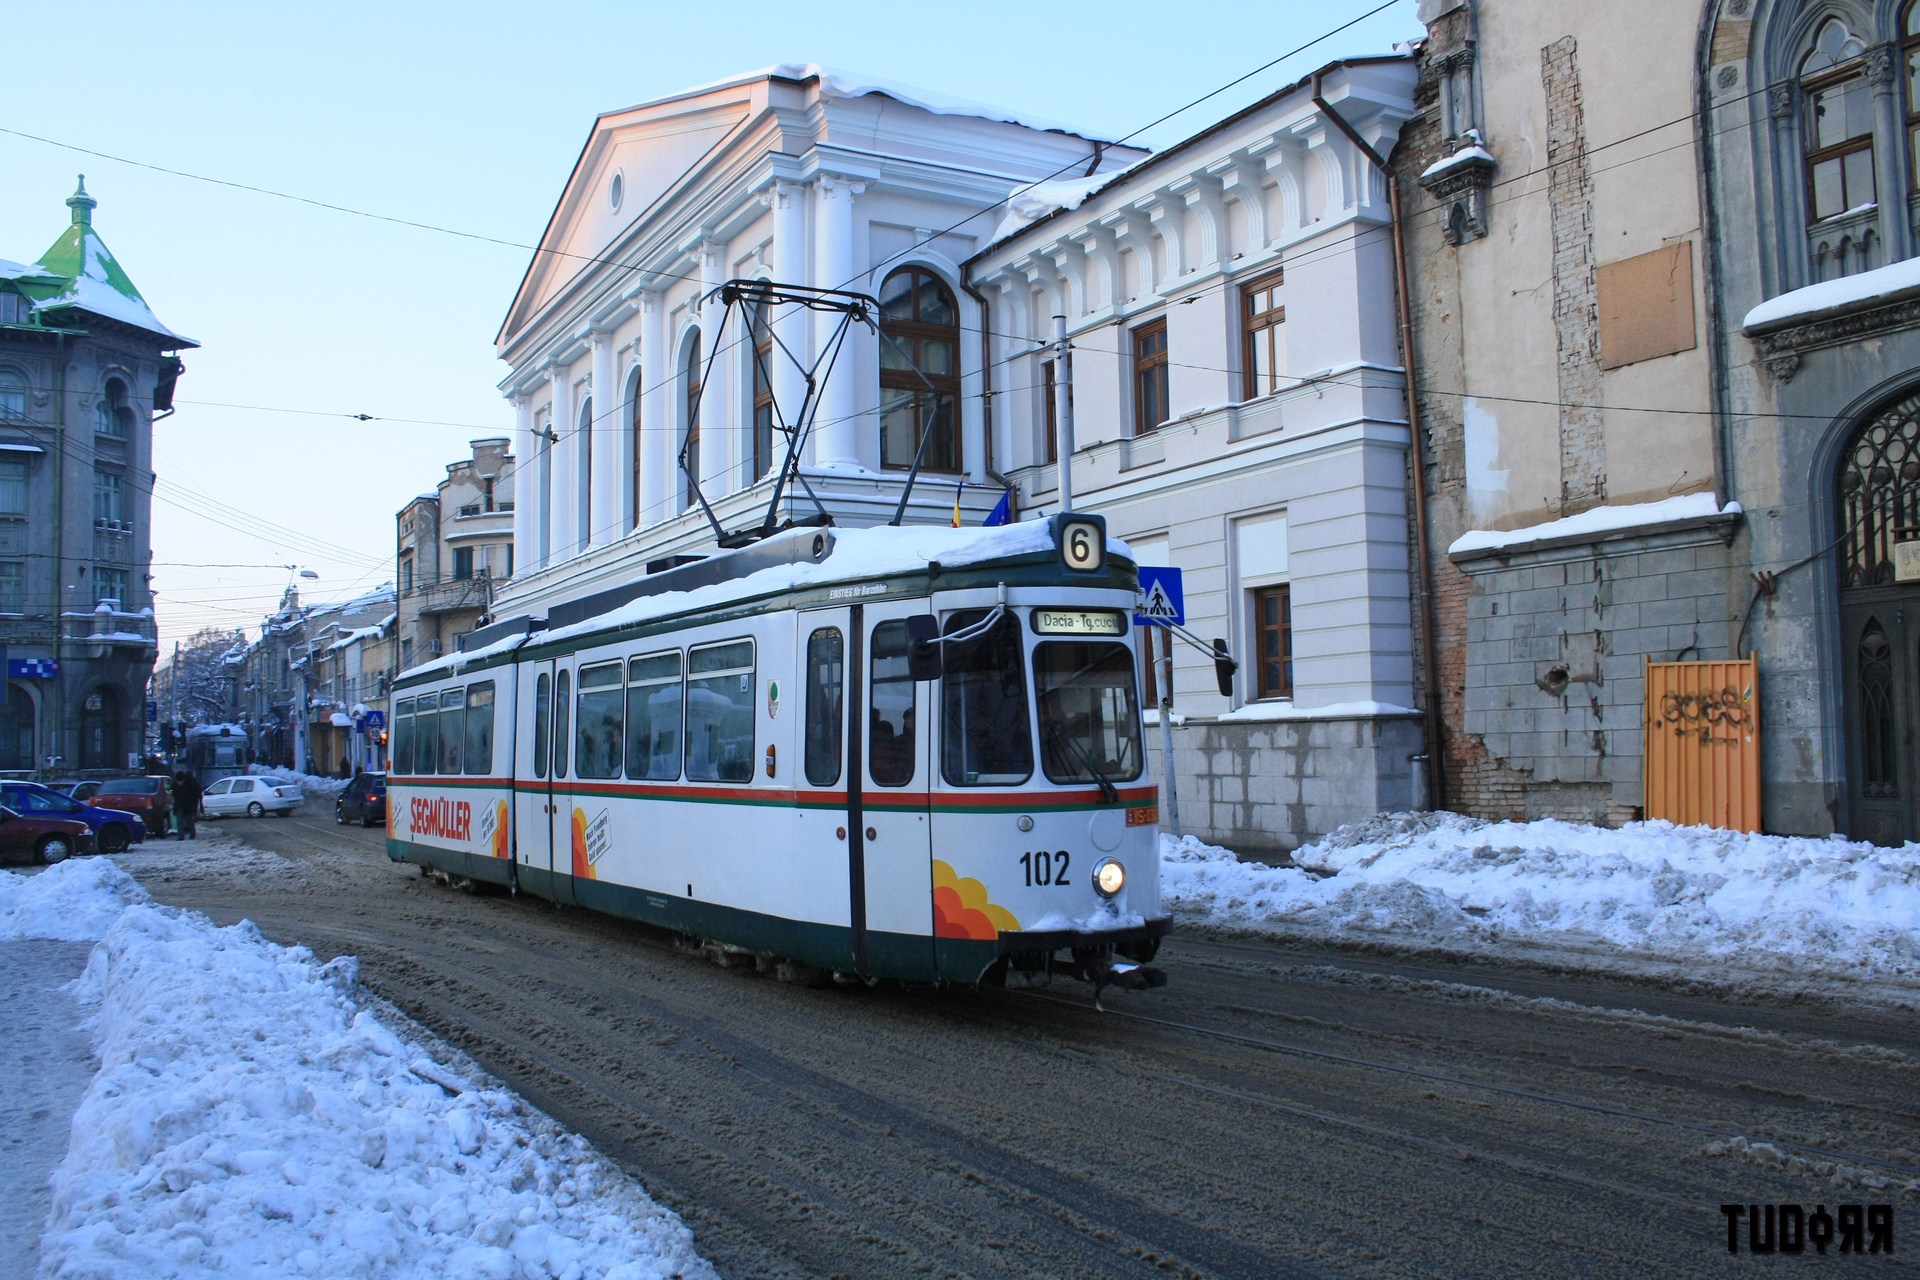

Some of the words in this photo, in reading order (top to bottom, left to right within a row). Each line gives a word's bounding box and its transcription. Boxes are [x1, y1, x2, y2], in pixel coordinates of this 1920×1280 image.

[1071, 528, 1090, 563] 6
[829, 588, 853, 600] EINSTIEG
[1043, 613, 1074, 627] Dacia
[410, 796, 471, 841] SEGMÜLLER
[1019, 850, 1070, 887] 102
